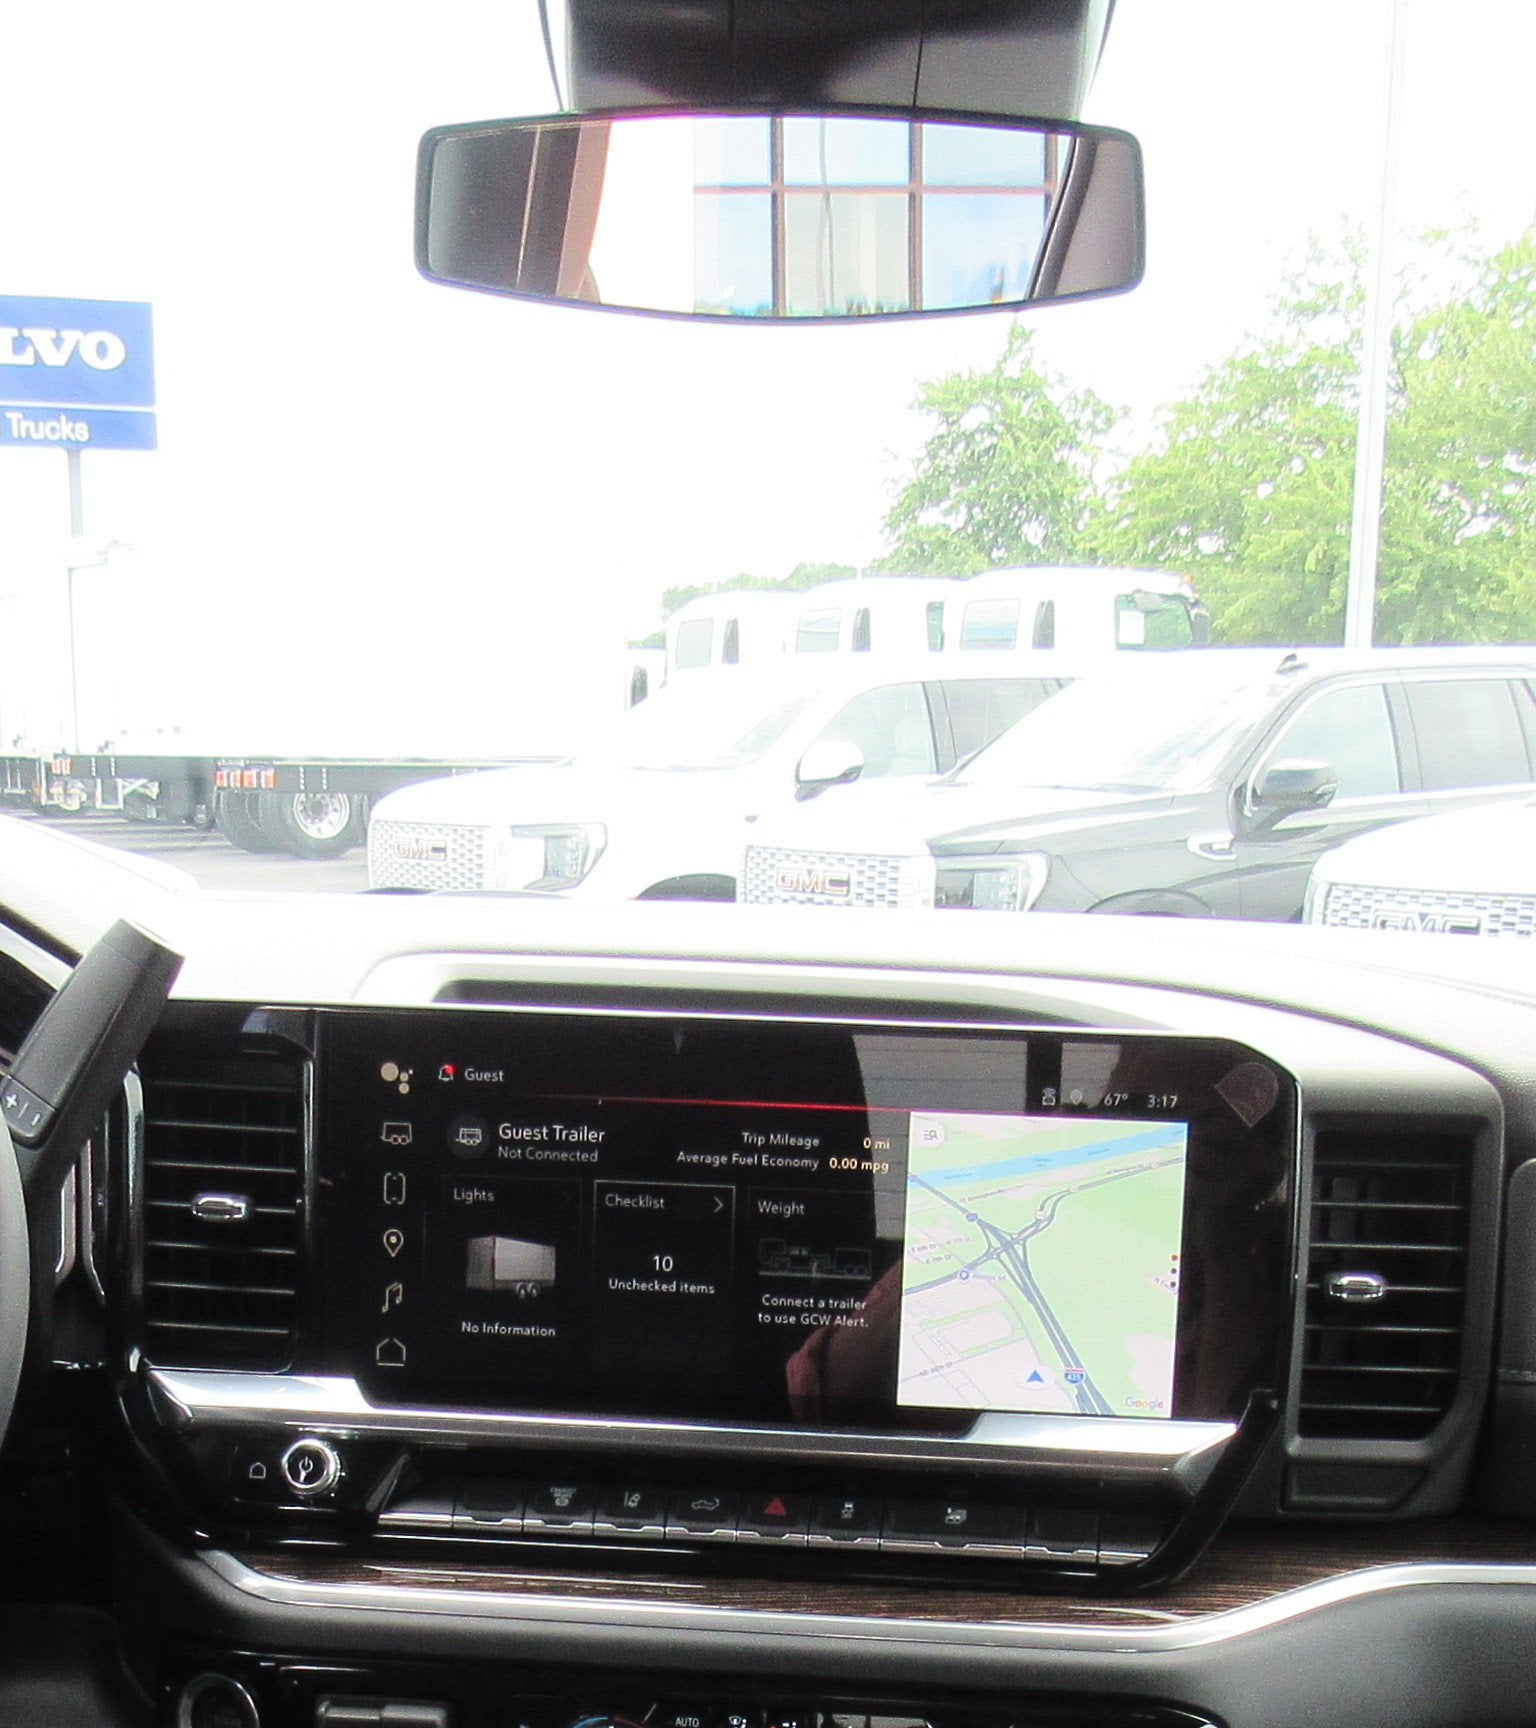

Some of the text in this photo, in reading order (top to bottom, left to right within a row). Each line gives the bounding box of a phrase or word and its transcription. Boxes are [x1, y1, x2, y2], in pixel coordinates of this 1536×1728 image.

[4, 411, 92, 443] Trucks
[776, 869, 850, 897] GMC
[464, 1068, 505, 1082] Guest
[1147, 1094, 1178, 1109] 3:17
[498, 1123, 606, 1143] Guest Trailer
[742, 1131, 820, 1149] Trip Mileage
[863, 1137, 891, 1150] 0 mi
[497, 1146, 599, 1163] Not Connected
[676, 1150, 820, 1171] Average Fuel Economy
[829, 1157, 890, 1174] 0.00 mpg
[453, 1188, 495, 1204] Lights
[605, 1193, 665, 1209] Checklist
[758, 1200, 805, 1218] Weight
[653, 1255, 674, 1272] 10
[609, 1278, 716, 1295] Unchecked items
[762, 1294, 867, 1311] Connect a trailer
[758, 1312, 869, 1328] to use GCW Alert.
[461, 1321, 556, 1337] No Information
[1125, 1396, 1165, 1411] Google
[675, 1715, 700, 1728] AUTO
